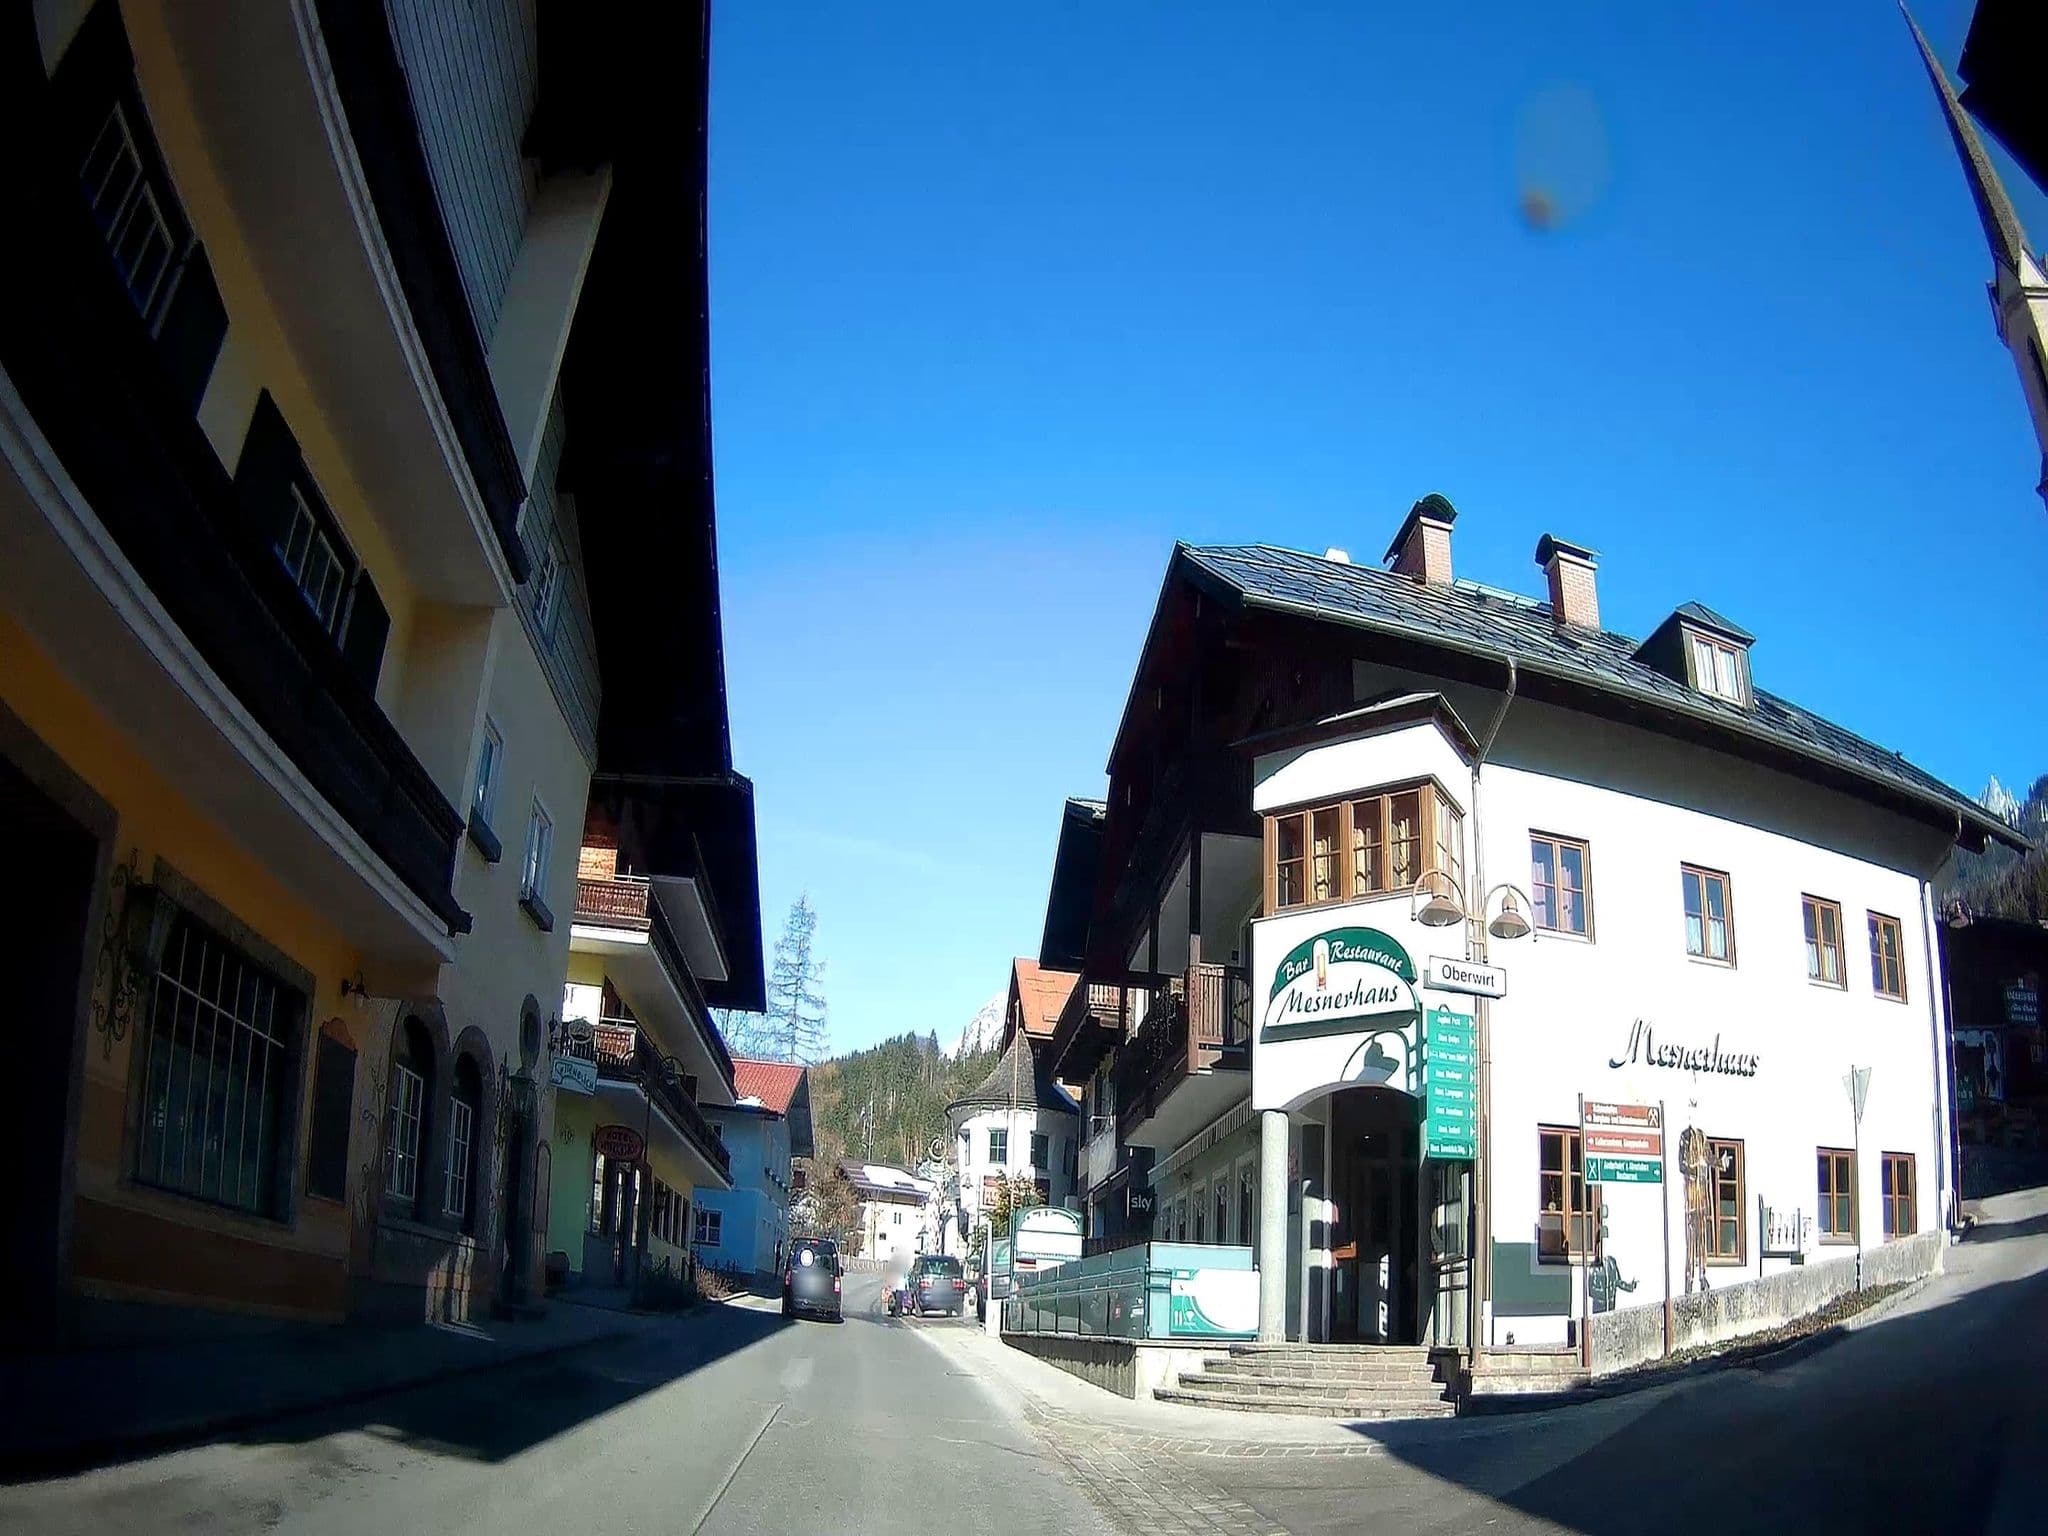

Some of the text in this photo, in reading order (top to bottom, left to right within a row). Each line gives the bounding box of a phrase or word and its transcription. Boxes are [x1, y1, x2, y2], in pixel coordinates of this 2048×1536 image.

[1281, 940, 1403, 980] Bar Restaurant
[1442, 964, 1494, 988] Oberwirt
[1277, 978, 1398, 1023] Mesnerhaus
[1131, 1194, 1152, 1212] sky
